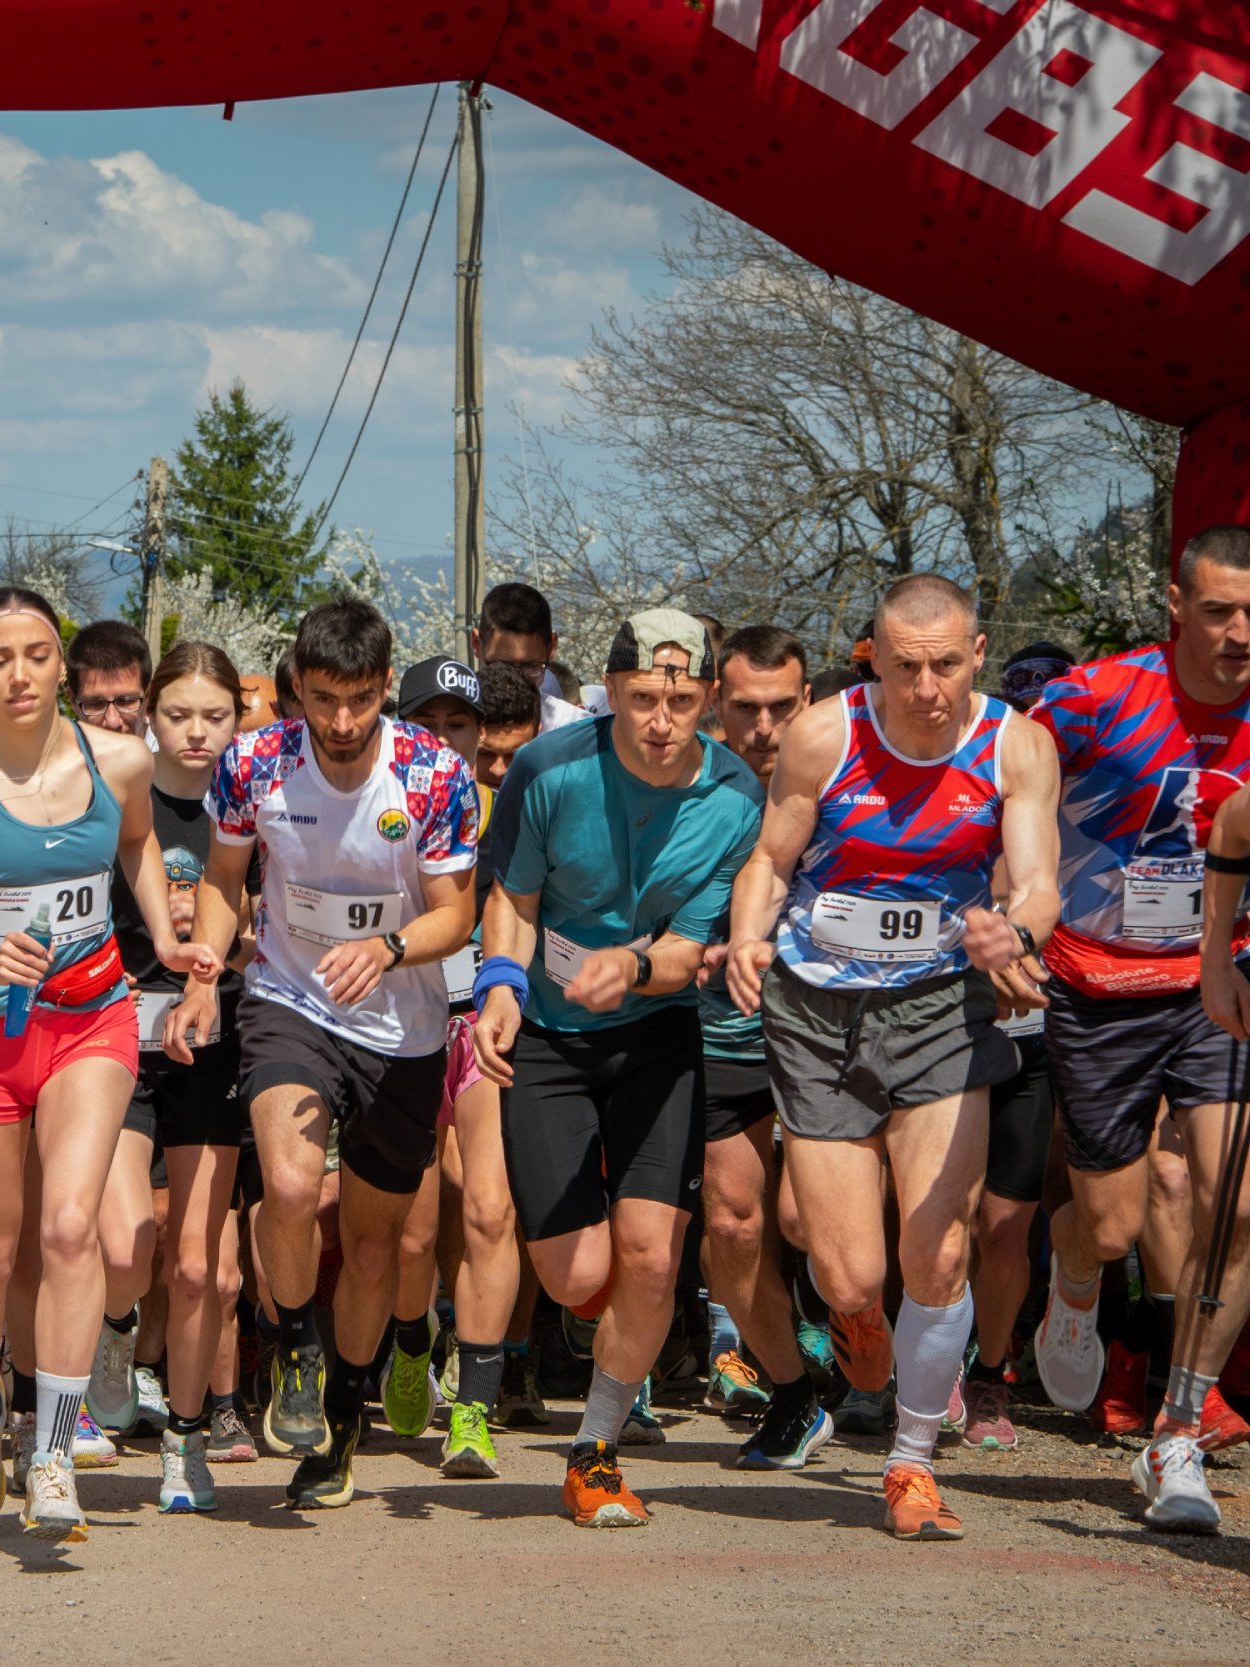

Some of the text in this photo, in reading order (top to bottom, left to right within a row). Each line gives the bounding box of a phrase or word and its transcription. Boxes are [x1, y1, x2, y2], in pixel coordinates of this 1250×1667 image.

[443, 666, 476, 697] Buff
[1200, 734, 1228, 745] ARDU
[853, 795, 886, 806] ARDU
[290, 815, 317, 825] ARDU
[1130, 864, 1159, 876] TEAM
[56, 885, 94, 923] 20
[347, 902, 384, 930] 97
[879, 908, 924, 941] 99
[1085, 967, 1156, 983] Absolute
[1105, 973, 1170, 991] Biokovo
[1119, 974, 1197, 995] Challenge
